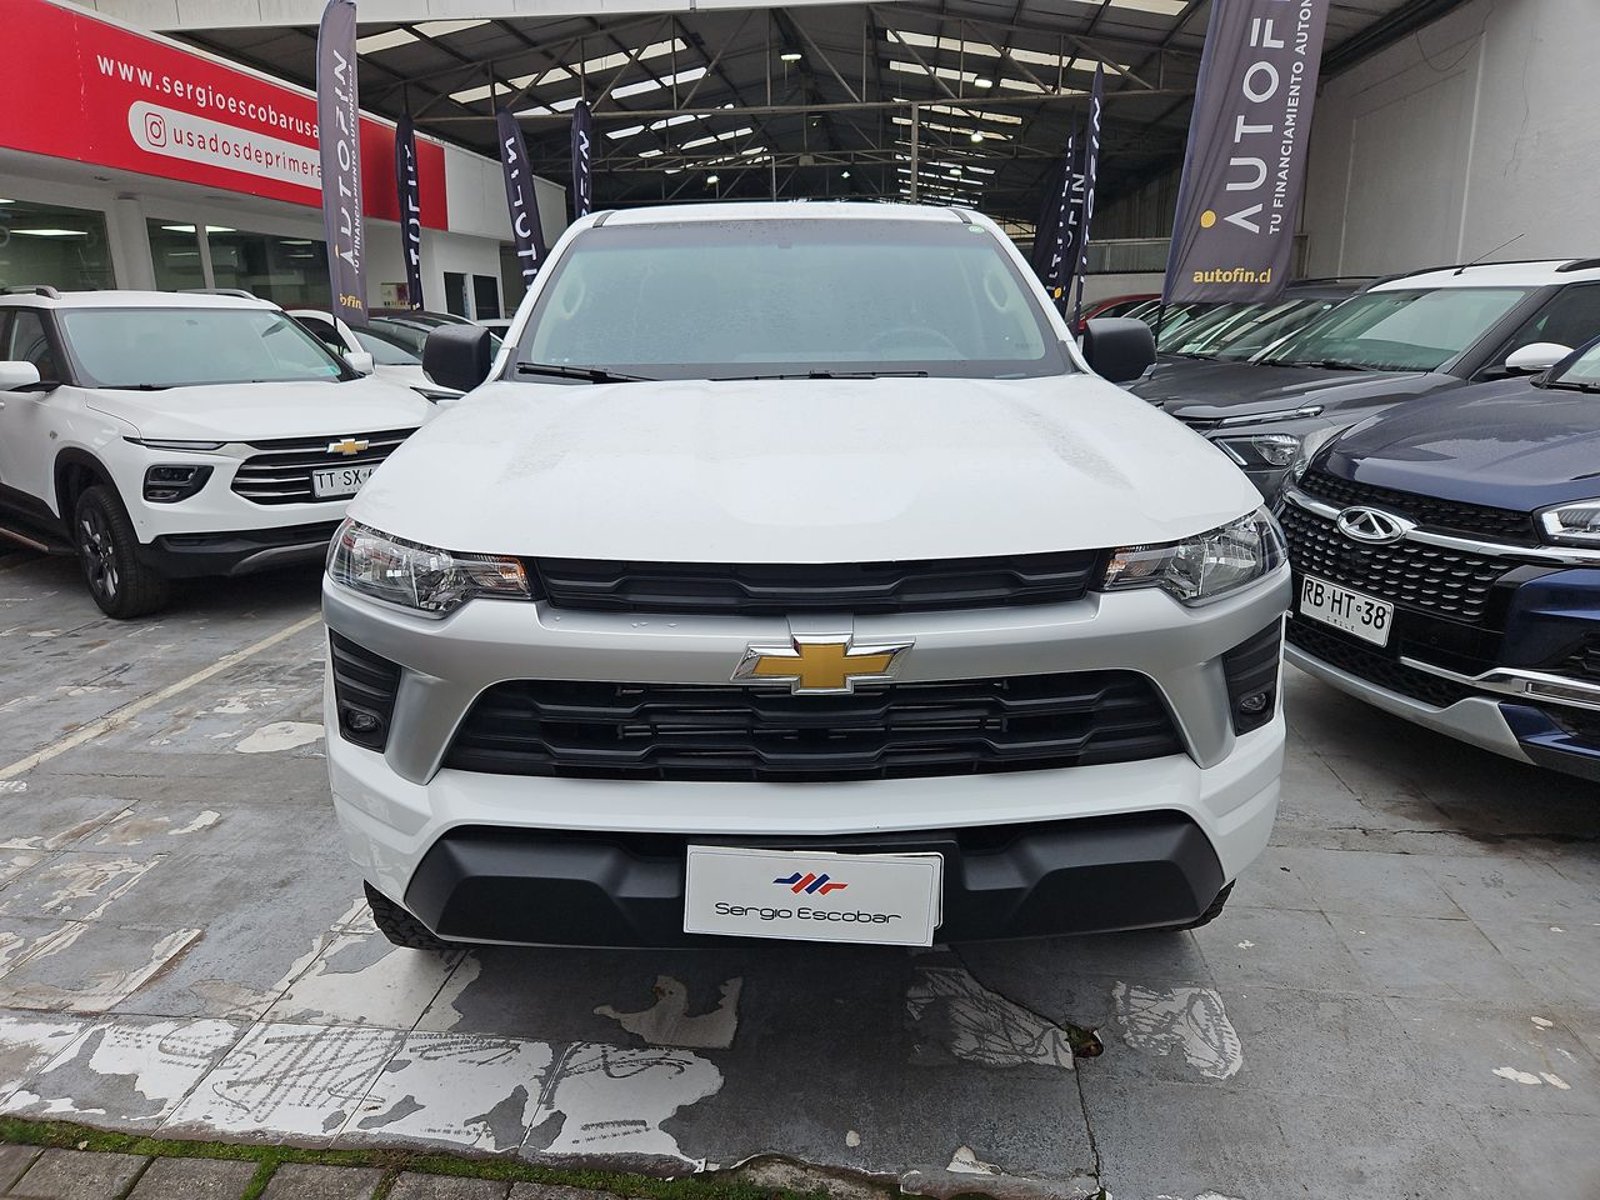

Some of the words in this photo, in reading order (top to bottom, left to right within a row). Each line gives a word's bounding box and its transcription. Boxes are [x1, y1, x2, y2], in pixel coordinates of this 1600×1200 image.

[1224, 0, 1290, 235] AUTOF
[1272, 61, 1304, 209] FINANCIAMIENTO
[1269, 214, 1282, 235] TU
[1193, 267, 1271, 284] autofin.cl
[714, 902, 793, 921] Sergio
[796, 907, 902, 924] Escobar
